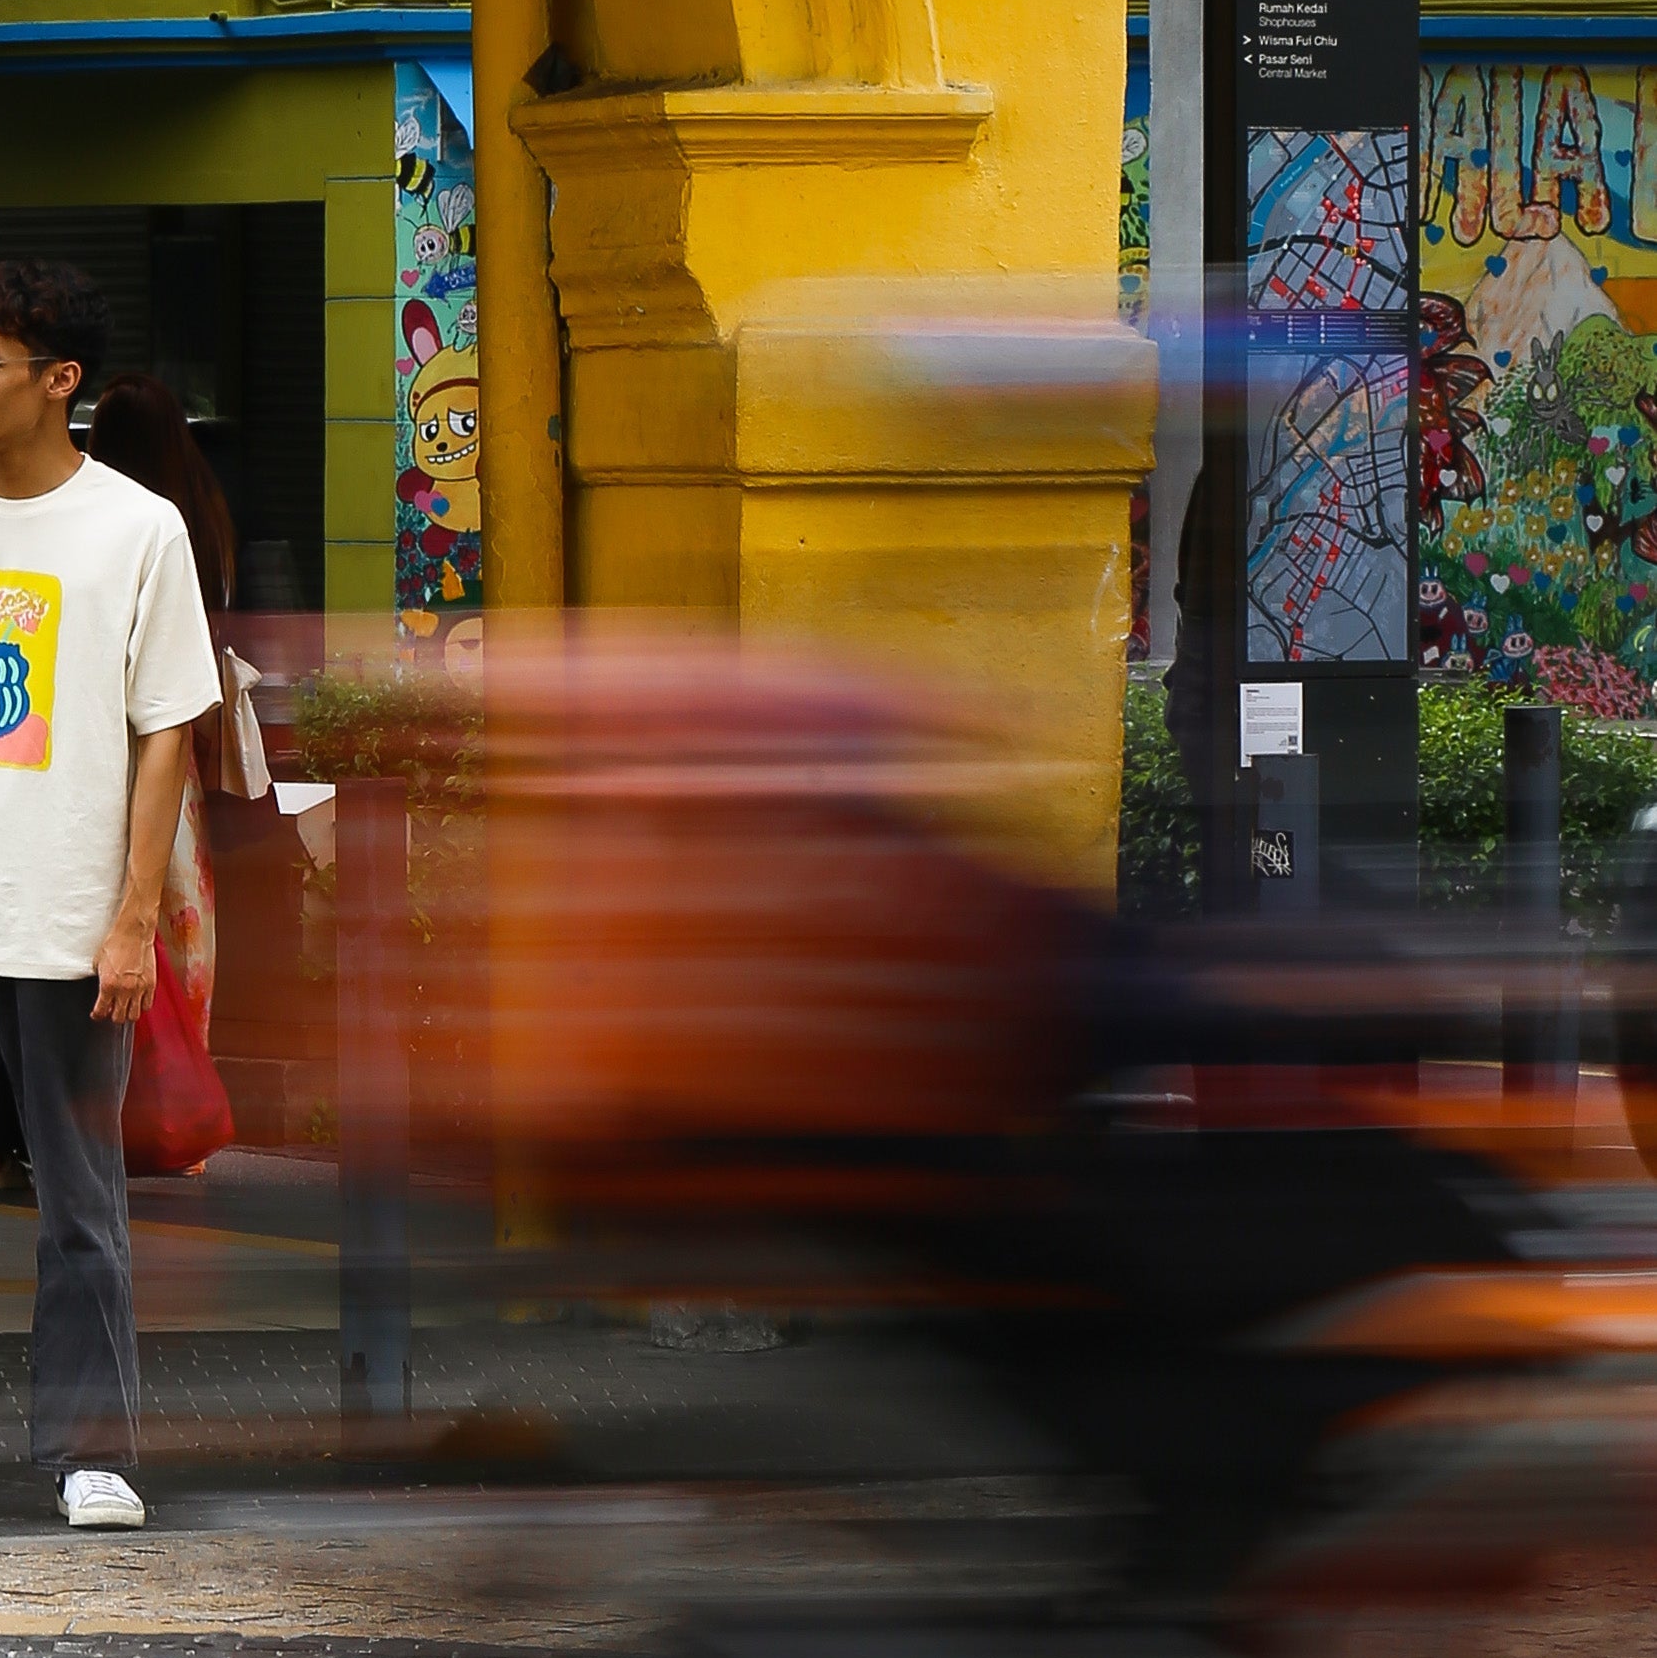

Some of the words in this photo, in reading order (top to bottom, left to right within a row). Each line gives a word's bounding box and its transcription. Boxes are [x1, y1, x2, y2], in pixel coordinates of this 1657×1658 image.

[1258, 2, 1295, 14] Rumah
[1296, 2, 1328, 14] Kedai
[1258, 17, 1317, 28] Shophouses
[1258, 35, 1294, 46] Wisma
[1295, 35, 1312, 46] Fui
[1314, 35, 1338, 46] Chiu
[1258, 54, 1288, 65] Pasar
[1290, 54, 1313, 65] Seni
[1258, 67, 1293, 79] Central
[1294, 67, 1327, 79] Market
[1420, 65, 1611, 247] ALA
